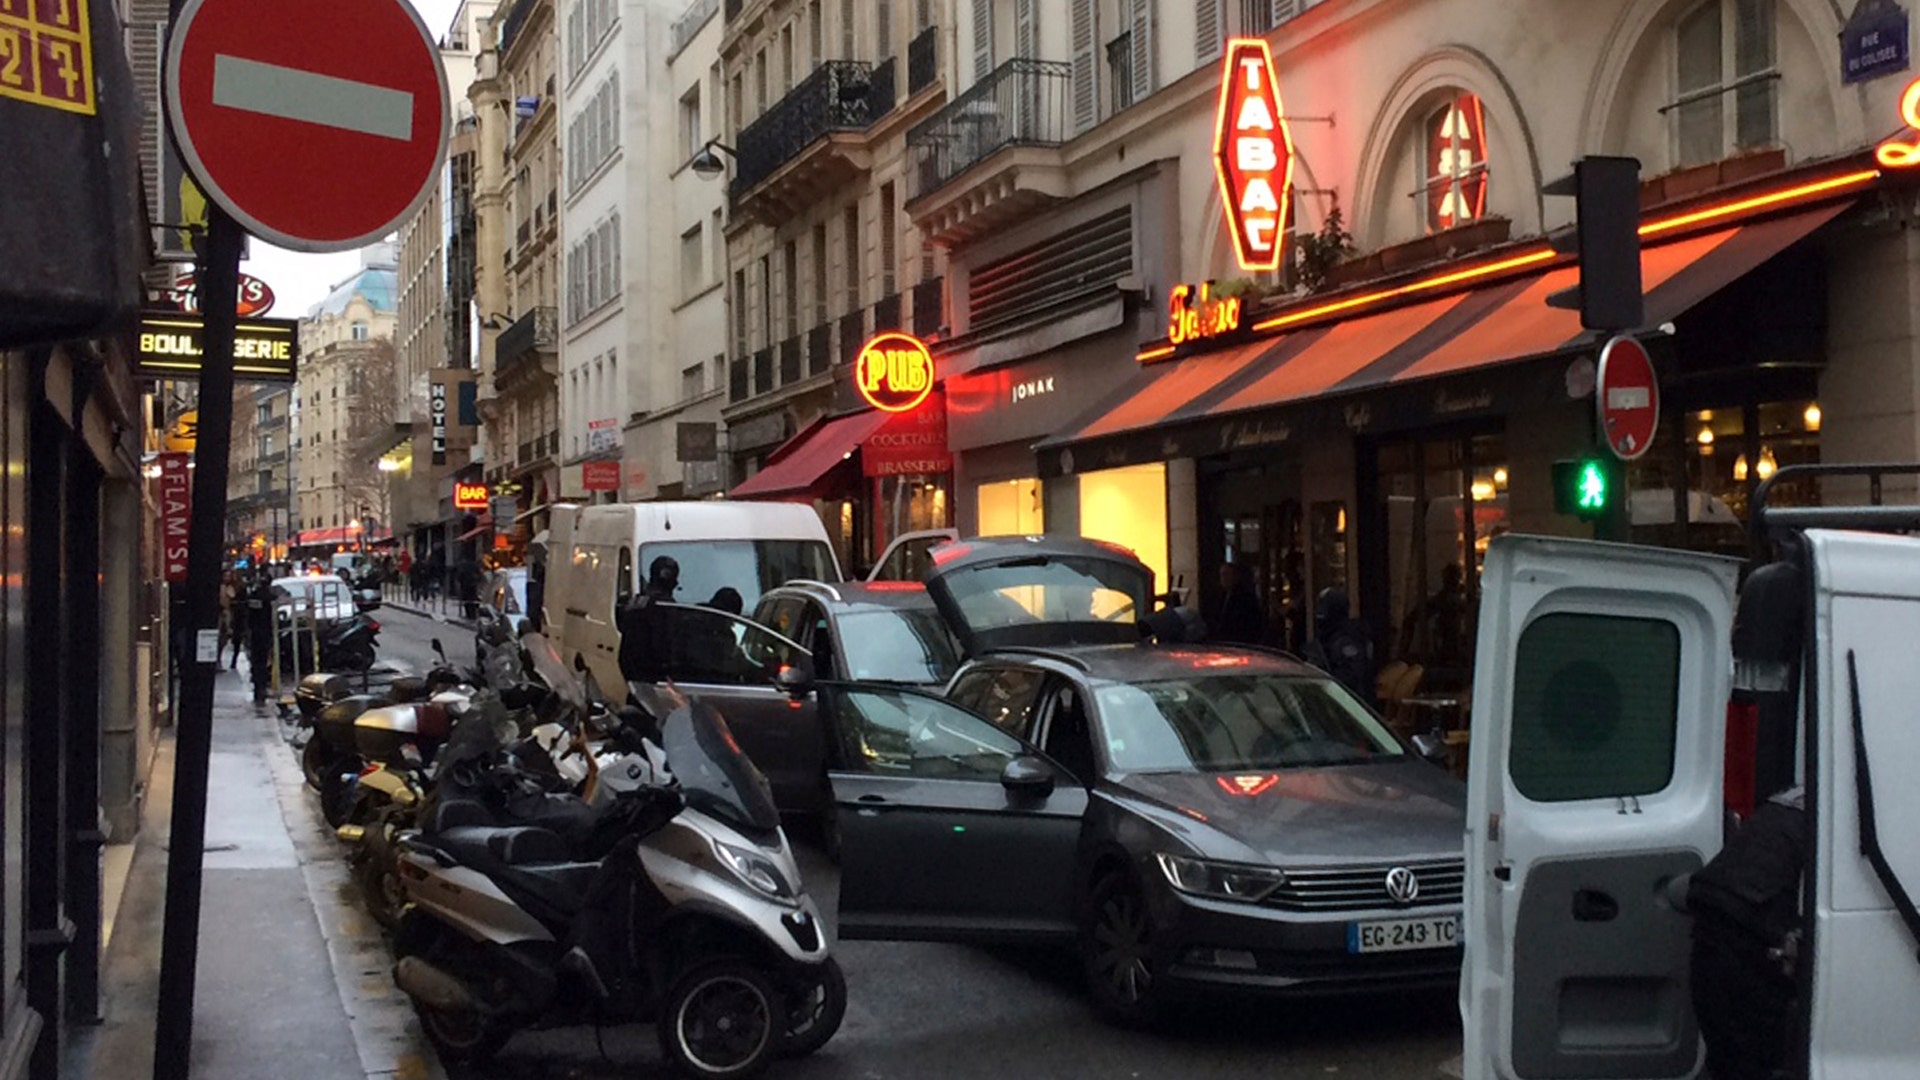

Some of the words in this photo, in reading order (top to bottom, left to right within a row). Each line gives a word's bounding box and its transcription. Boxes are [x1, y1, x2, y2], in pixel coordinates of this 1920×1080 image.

[1236, 57, 1278, 251] TABAC
[867, 350, 926, 391] PUB
[1012, 377, 1054, 404] JONAK
[432, 385, 445, 452] HOTEL
[165, 474, 188, 560] FLAM'S
[460, 486, 486, 500] BAR
